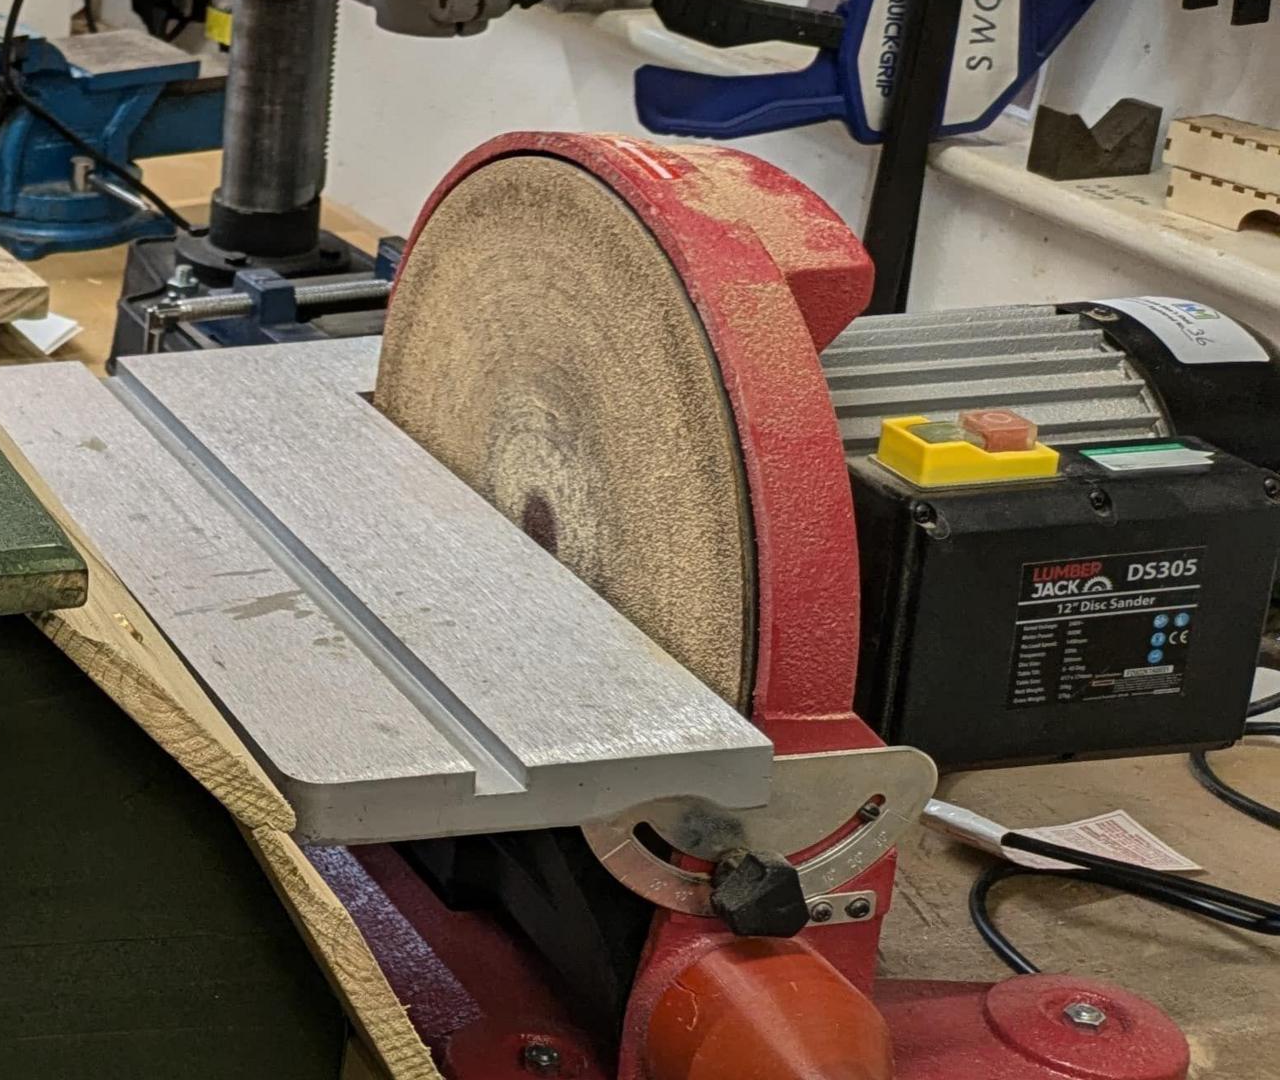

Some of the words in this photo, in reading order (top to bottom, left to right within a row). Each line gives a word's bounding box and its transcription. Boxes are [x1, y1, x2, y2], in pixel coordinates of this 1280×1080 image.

[1032, 561, 1103, 582] LUMBER
[1127, 558, 1198, 582] DS305
[1031, 580, 1080, 598] JACK
[1080, 599, 1108, 613] Disc
[1110, 595, 1157, 610] Sander
